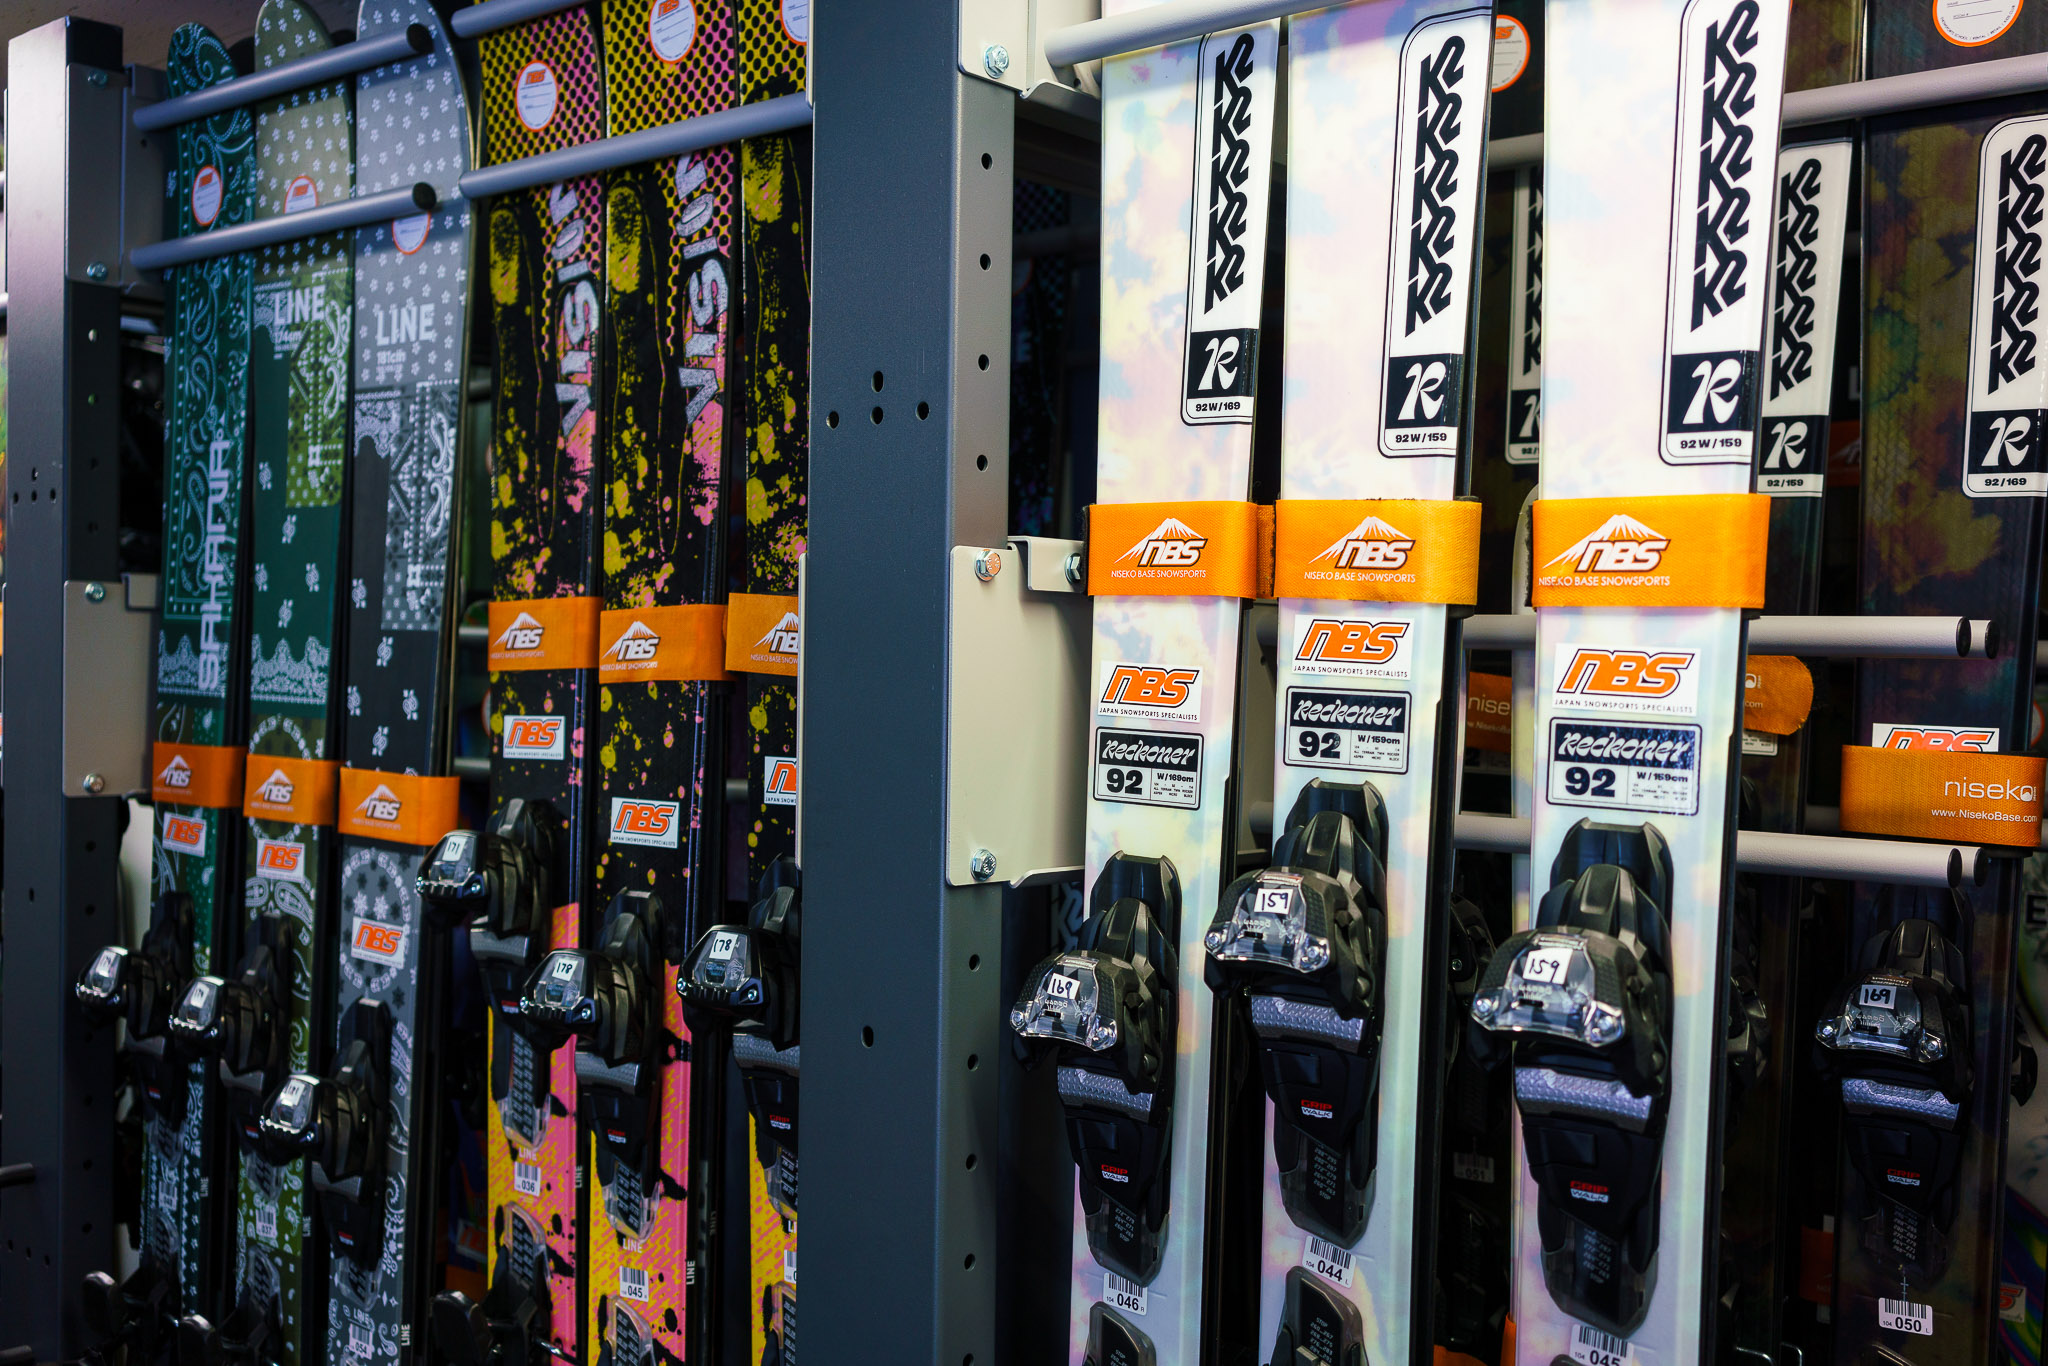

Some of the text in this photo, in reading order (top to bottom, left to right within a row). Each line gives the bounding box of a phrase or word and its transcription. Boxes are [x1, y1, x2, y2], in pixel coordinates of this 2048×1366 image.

[274, 285, 326, 326] LINE
[376, 303, 435, 346] LINE
[1137, 538, 1208, 568] NBS
[1334, 538, 1416, 570] NBS
[1574, 538, 1671, 573] NBS
[1111, 569, 1207, 579] NISEKO BASE SNOWSPORTS
[1304, 572, 1416, 583] NISEKO BASE SNOWSPORTS
[1538, 576, 1670, 587] NISEKO BASE SNOWSPORTS
[1295, 618, 1411, 665] NBS
[1318, 666, 1363, 675] SNOWSPORTS
[1366, 669, 1408, 678] SPECIALISTS
[1556, 648, 1695, 699] NBS
[1101, 665, 1200, 709] NBS
[1293, 698, 1402, 726] Reckoner
[1467, 694, 1511, 716] nise
[1555, 698, 1693, 714] JAPAN SNOWSPORTS SPECIALISTS
[1099, 707, 1198, 721] JAPAN SNOWSPORTS SPECIALISTS
[1102, 739, 1195, 765] Reckoner
[1299, 731, 1341, 759] 92
[1558, 731, 1690, 762] Reckoner
[1106, 768, 1143, 795] 92
[1565, 767, 1616, 797] 92
[1931, 808, 2038, 823] www.NisekoBase.com
[1262, 892, 1289, 911] 159
[714, 938, 733, 952] 178
[556, 962, 573, 975] 178
[1529, 958, 1560, 983] 159
[1051, 978, 1073, 1000] 169
[1864, 988, 1891, 1004] 169
[1301, 1099, 1333, 1110] GRIP
[1301, 1106, 1333, 1119] WALK
[518, 1147, 537, 1161] LINE
[1101, 1164, 1128, 1175] GRIP
[1101, 1170, 1128, 1183] WALK
[1887, 1168, 1921, 1179] GRIP
[521, 1180, 536, 1193] 036
[1570, 1180, 1609, 1193] GRIP
[1887, 1175, 1921, 1186] WALK
[1570, 1188, 1609, 1203] WALK
[787, 1220, 798, 1234] LI
[622, 1238, 643, 1254] LINE
[686, 1260, 695, 1285] LINE
[1305, 1259, 1315, 1268] 104
[1316, 1263, 1344, 1282] 044
[627, 1285, 643, 1299] 045
[1117, 1293, 1140, 1312] 046
[1882, 1319, 1893, 1327] 104
[1894, 1316, 1922, 1333] 050
[401, 1323, 411, 1346] LINE
[1574, 1351, 1585, 1360] 104
